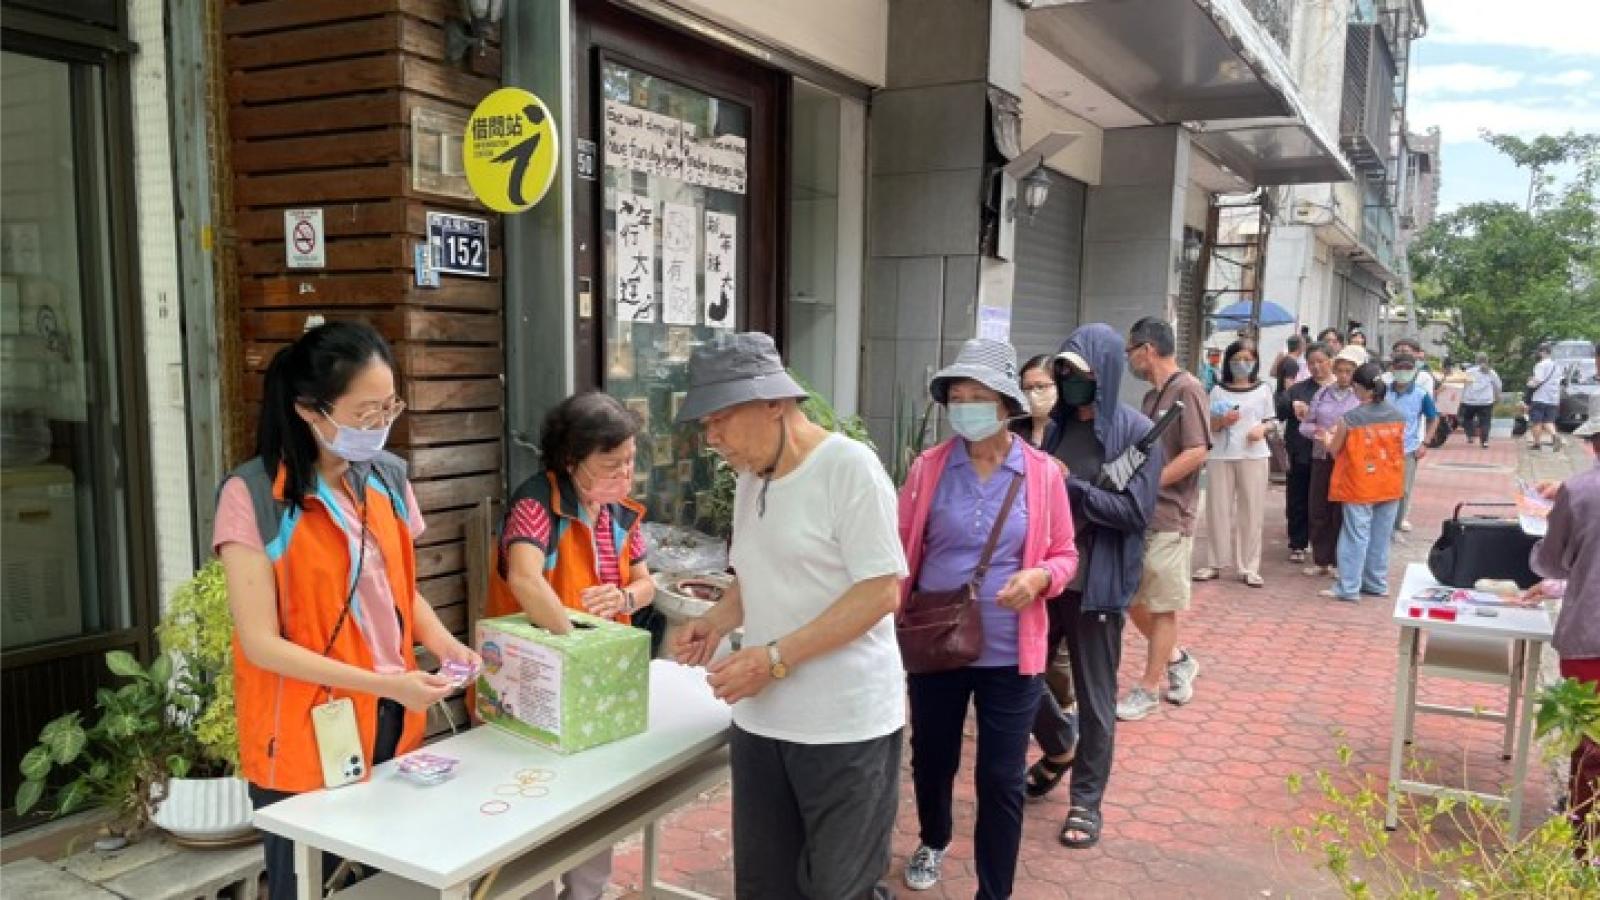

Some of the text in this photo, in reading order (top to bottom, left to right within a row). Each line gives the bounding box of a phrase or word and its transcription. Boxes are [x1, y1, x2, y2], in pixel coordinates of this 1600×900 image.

[472, 114, 523, 140] 借問站
[446, 235, 482, 267] 152
